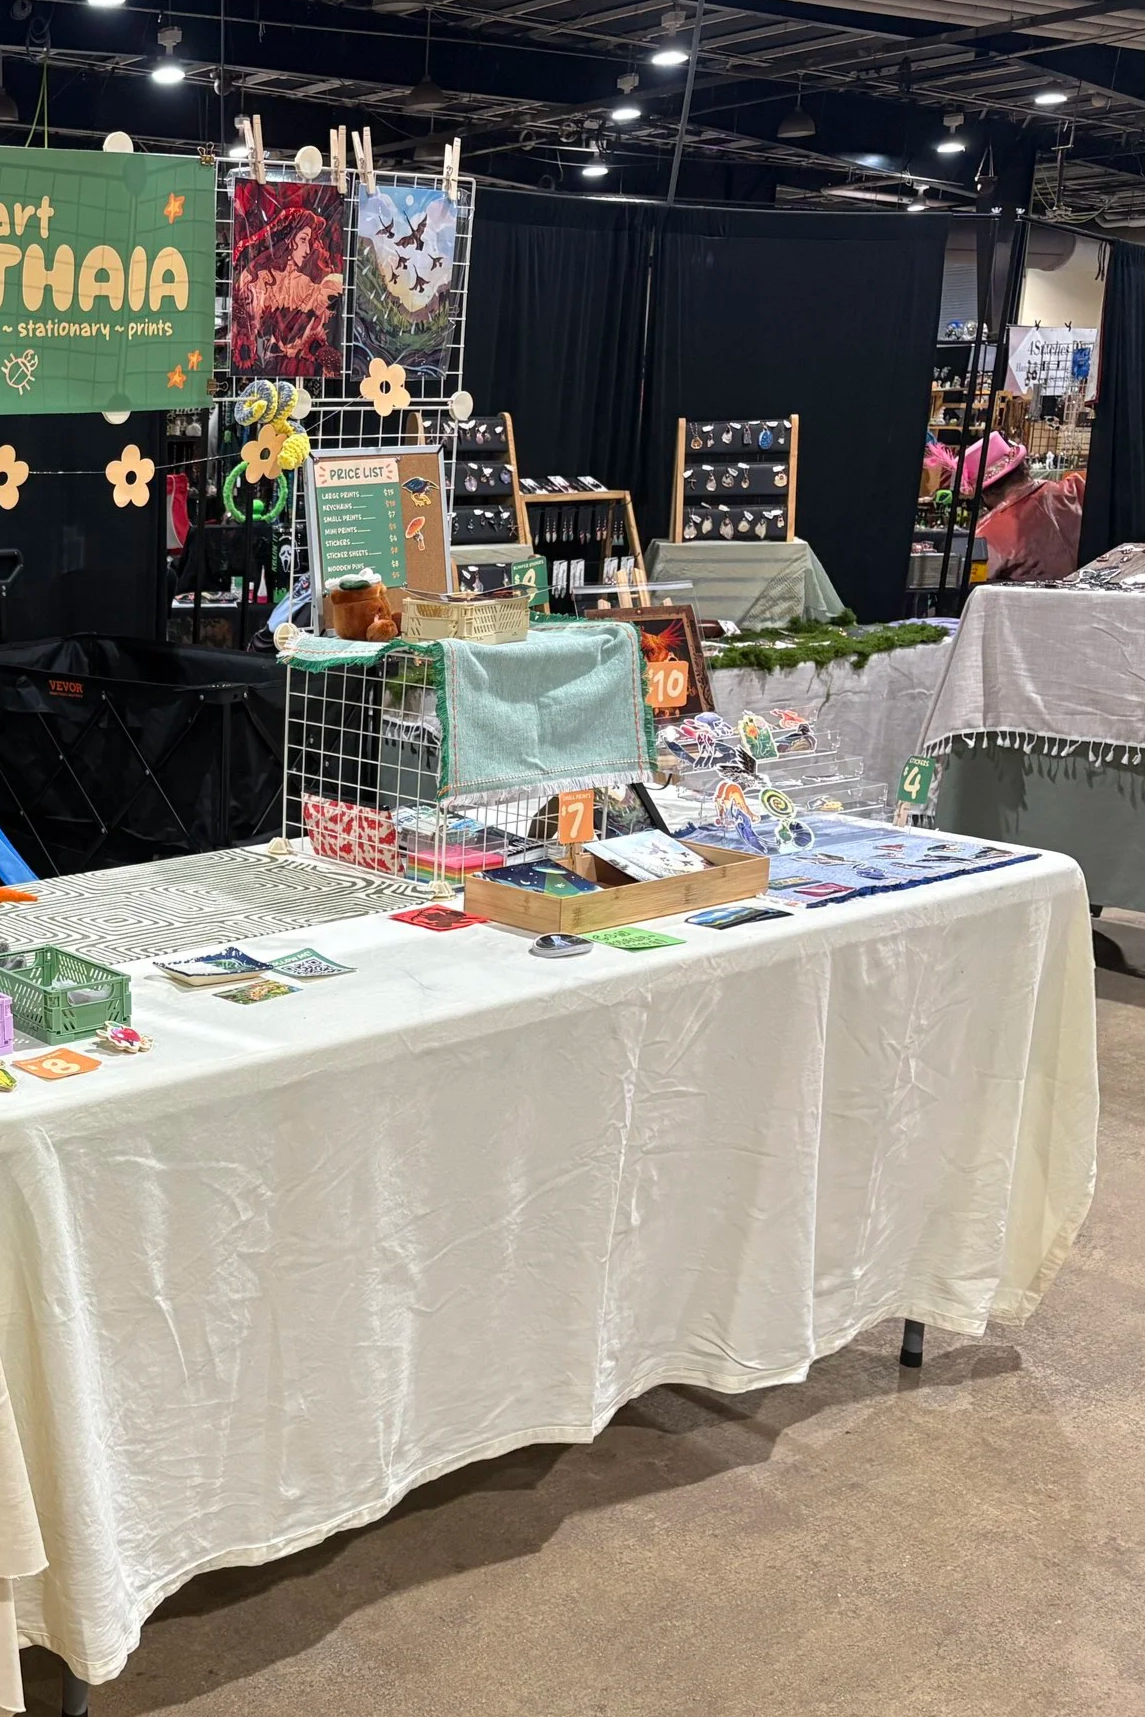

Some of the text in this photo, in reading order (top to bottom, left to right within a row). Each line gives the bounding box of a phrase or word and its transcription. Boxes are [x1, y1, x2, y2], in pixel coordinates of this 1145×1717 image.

[17, 318, 111, 340] stationary
[127, 319, 174, 340] prints
[329, 466, 385, 480] PRICE LIST
[321, 492, 340, 500] LARGE
[322, 502, 353, 512] KEYCHAINS
[342, 513, 362, 521] PRINTS
[324, 528, 338, 536] MINI
[338, 526, 358, 534] PRINTS
[325, 538, 351, 547] STICKERS
[326, 551, 349, 560] STICKER
[348, 549, 369, 558] SHEETS
[327, 564, 352, 573] WOODEN
[351, 562, 365, 570] PINS
[48, 679, 84, 693] VEVOR
[903, 765, 922, 800] $4
[561, 802, 585, 839] $7
